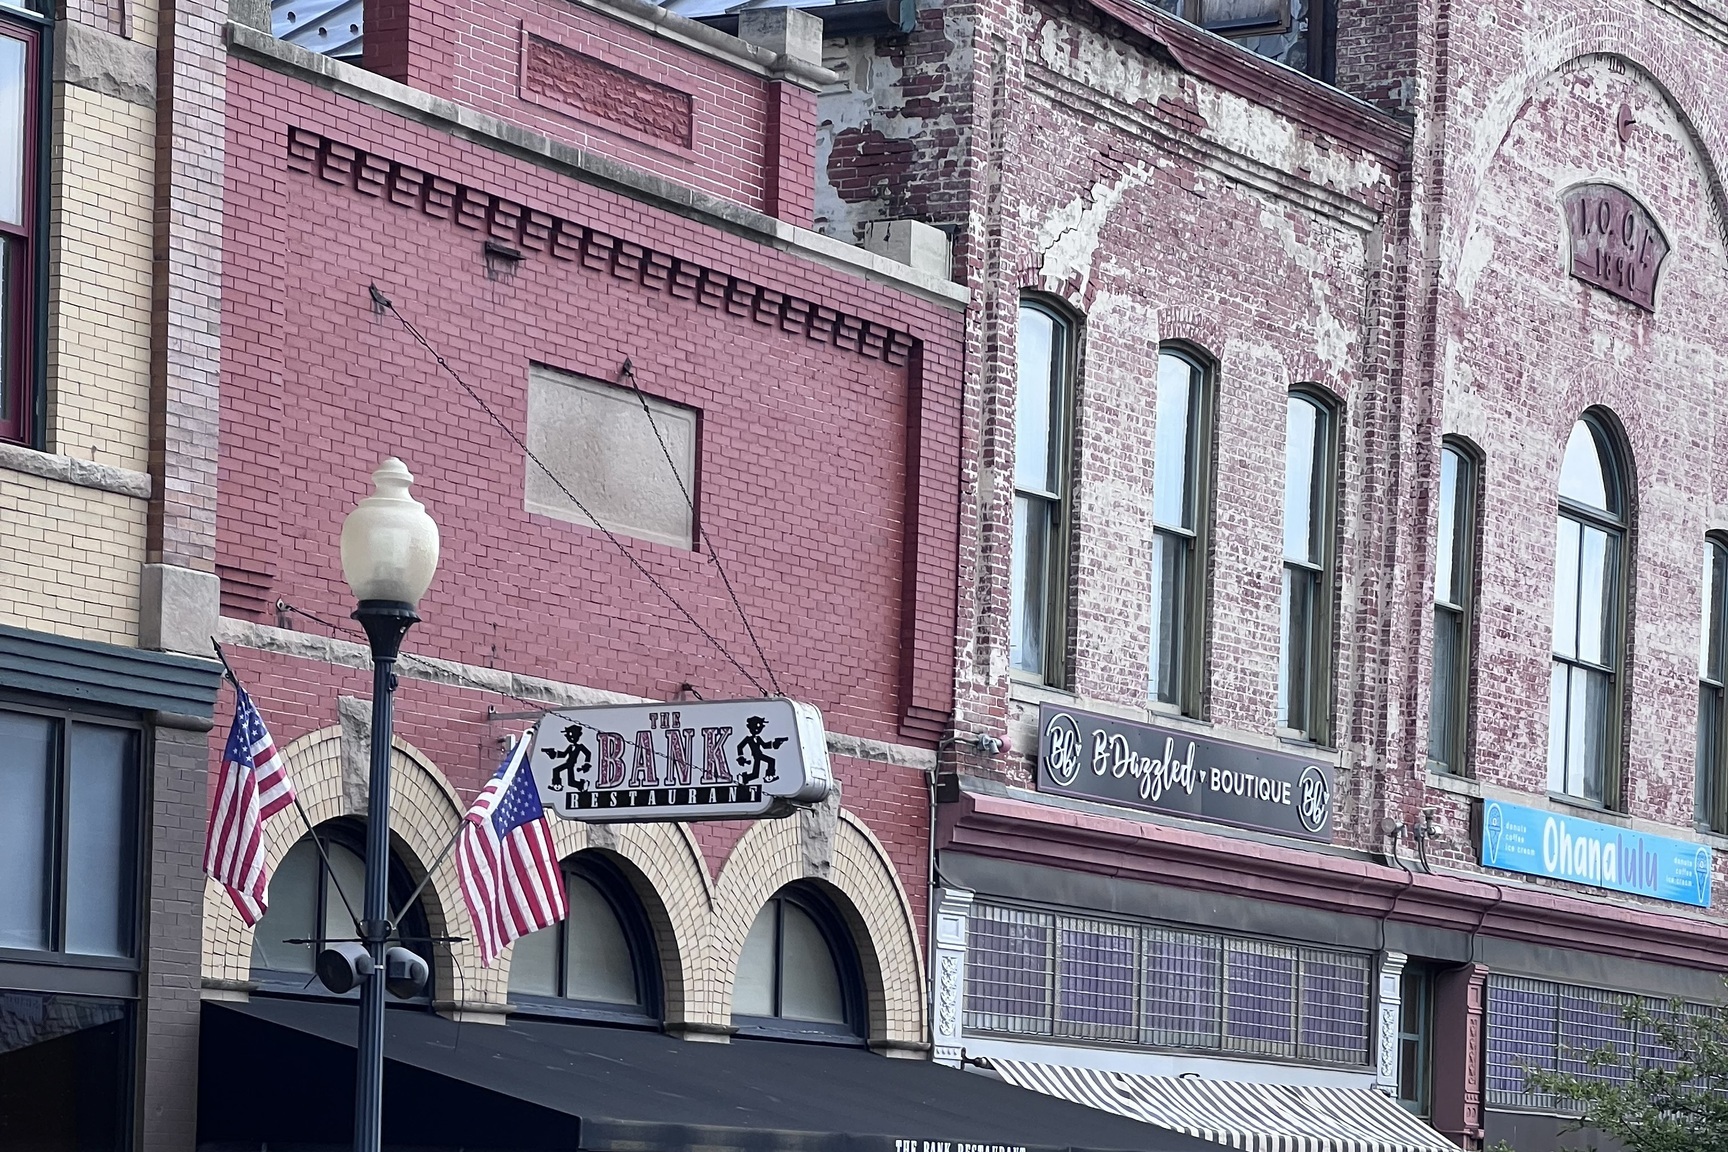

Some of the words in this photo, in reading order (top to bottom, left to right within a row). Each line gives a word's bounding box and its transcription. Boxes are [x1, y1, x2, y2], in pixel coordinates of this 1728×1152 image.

[1595, 247, 1635, 292] 1890
[650, 712, 681, 730] THE
[595, 726, 733, 789] BANK
[570, 785, 758, 808] RESTAURANT
[1210, 768, 1292, 806] BOUTIQUE
[1505, 833, 1525, 844] coffee
[1505, 843, 1515, 853] ice
[1517, 846, 1536, 856] cream
[1543, 816, 1658, 892] Ohanalulu
